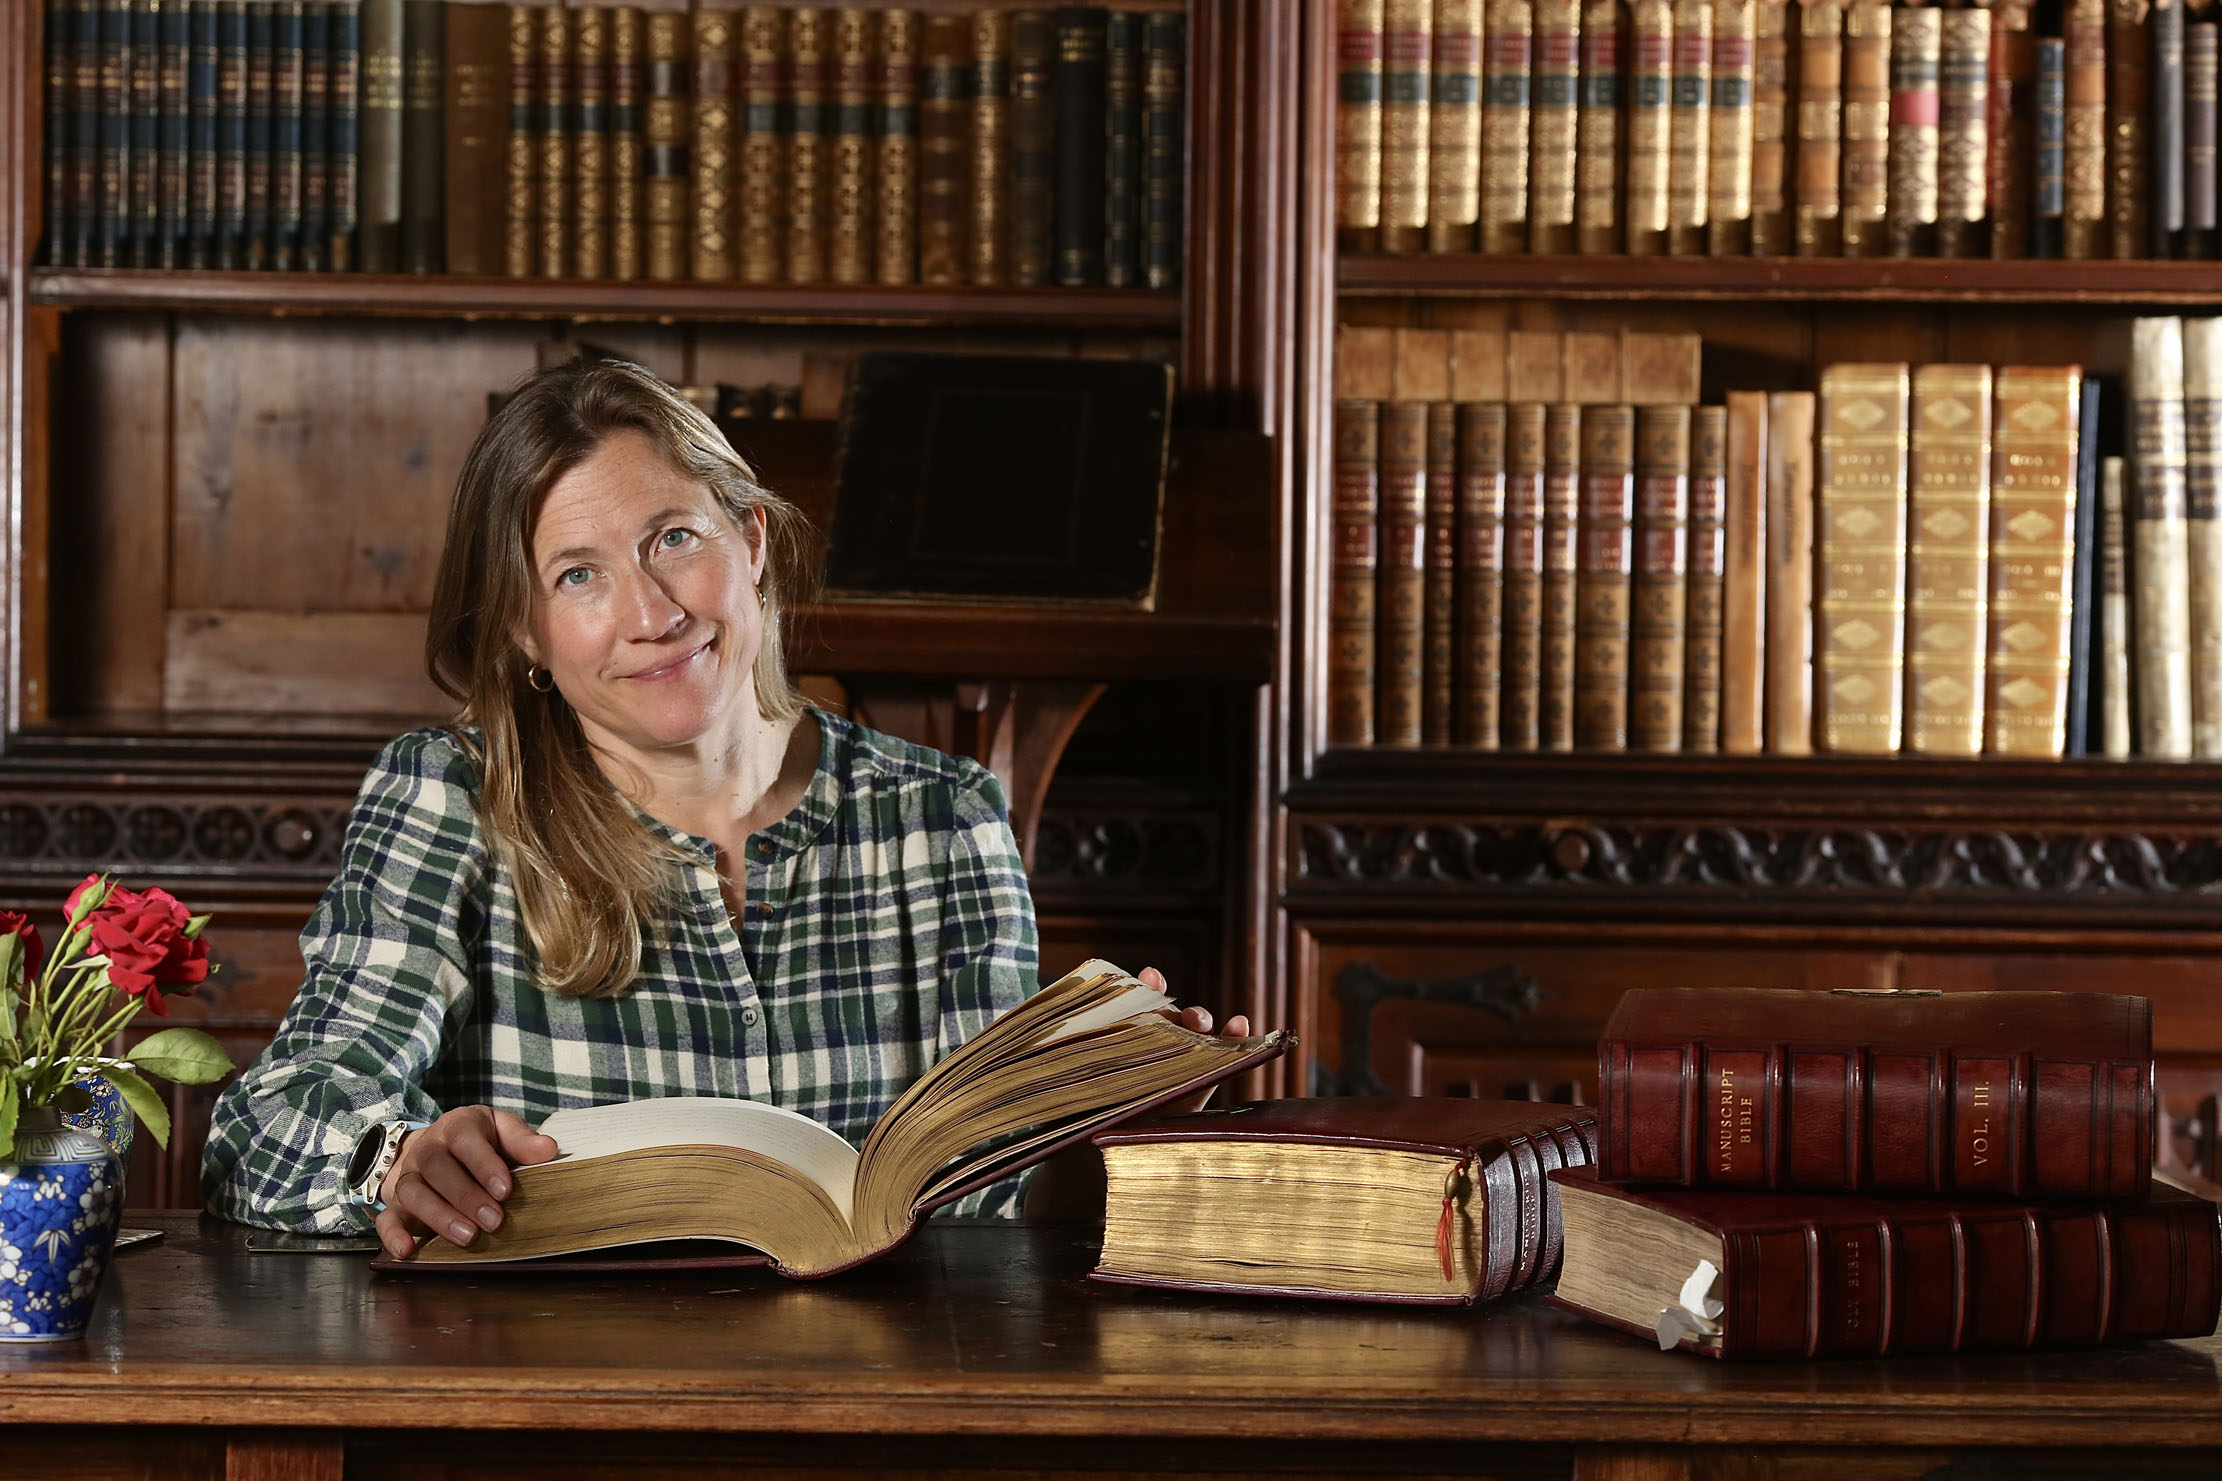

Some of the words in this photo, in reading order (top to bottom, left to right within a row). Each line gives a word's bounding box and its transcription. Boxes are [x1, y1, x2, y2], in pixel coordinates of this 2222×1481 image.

[1973, 1081, 1989, 1107] III.
[1720, 1067, 1734, 1173] MANUSCRIPT
[1740, 1097, 1752, 1143] BIBLE
[1973, 1118, 1989, 1167] VOL.
[1847, 1241, 1859, 1288] BIBLE
